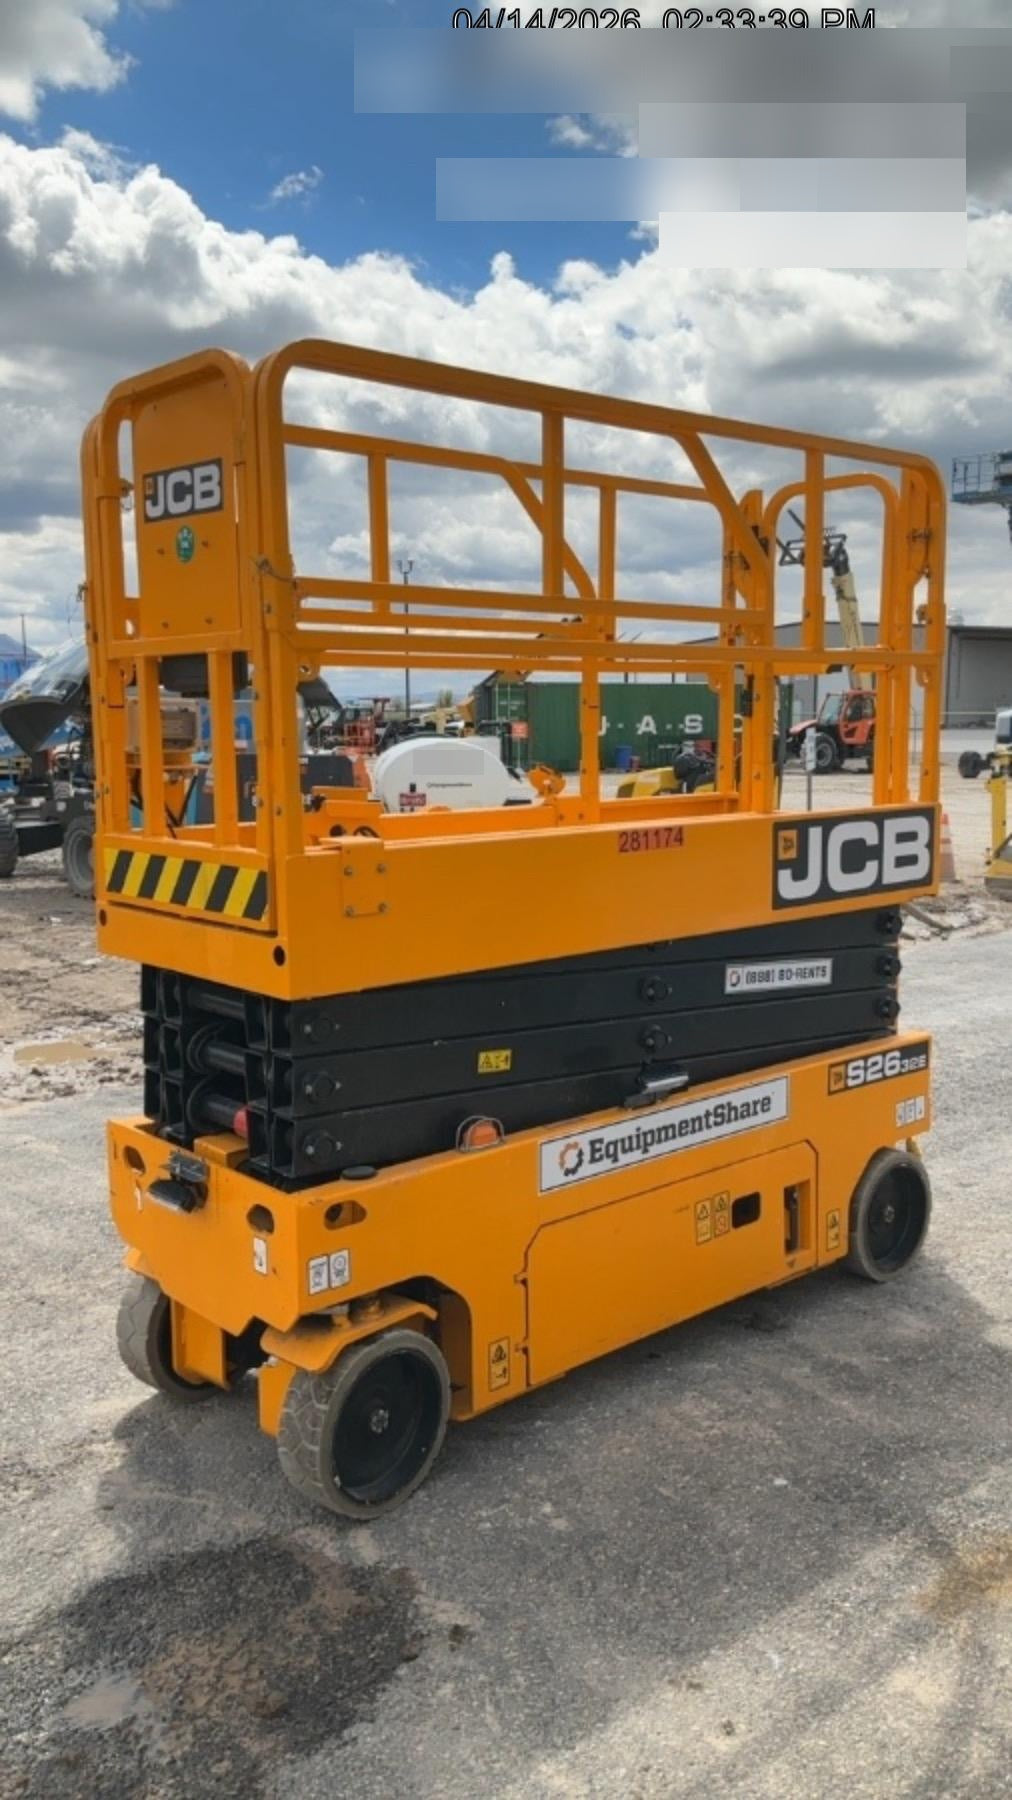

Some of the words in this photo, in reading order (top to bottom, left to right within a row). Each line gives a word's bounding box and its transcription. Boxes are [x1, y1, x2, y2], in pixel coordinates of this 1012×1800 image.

[145, 463, 221, 518] JCB
[618, 825, 684, 853] 281174
[777, 815, 931, 900] JCB
[588, 1093, 772, 1165] EquipmentShare
